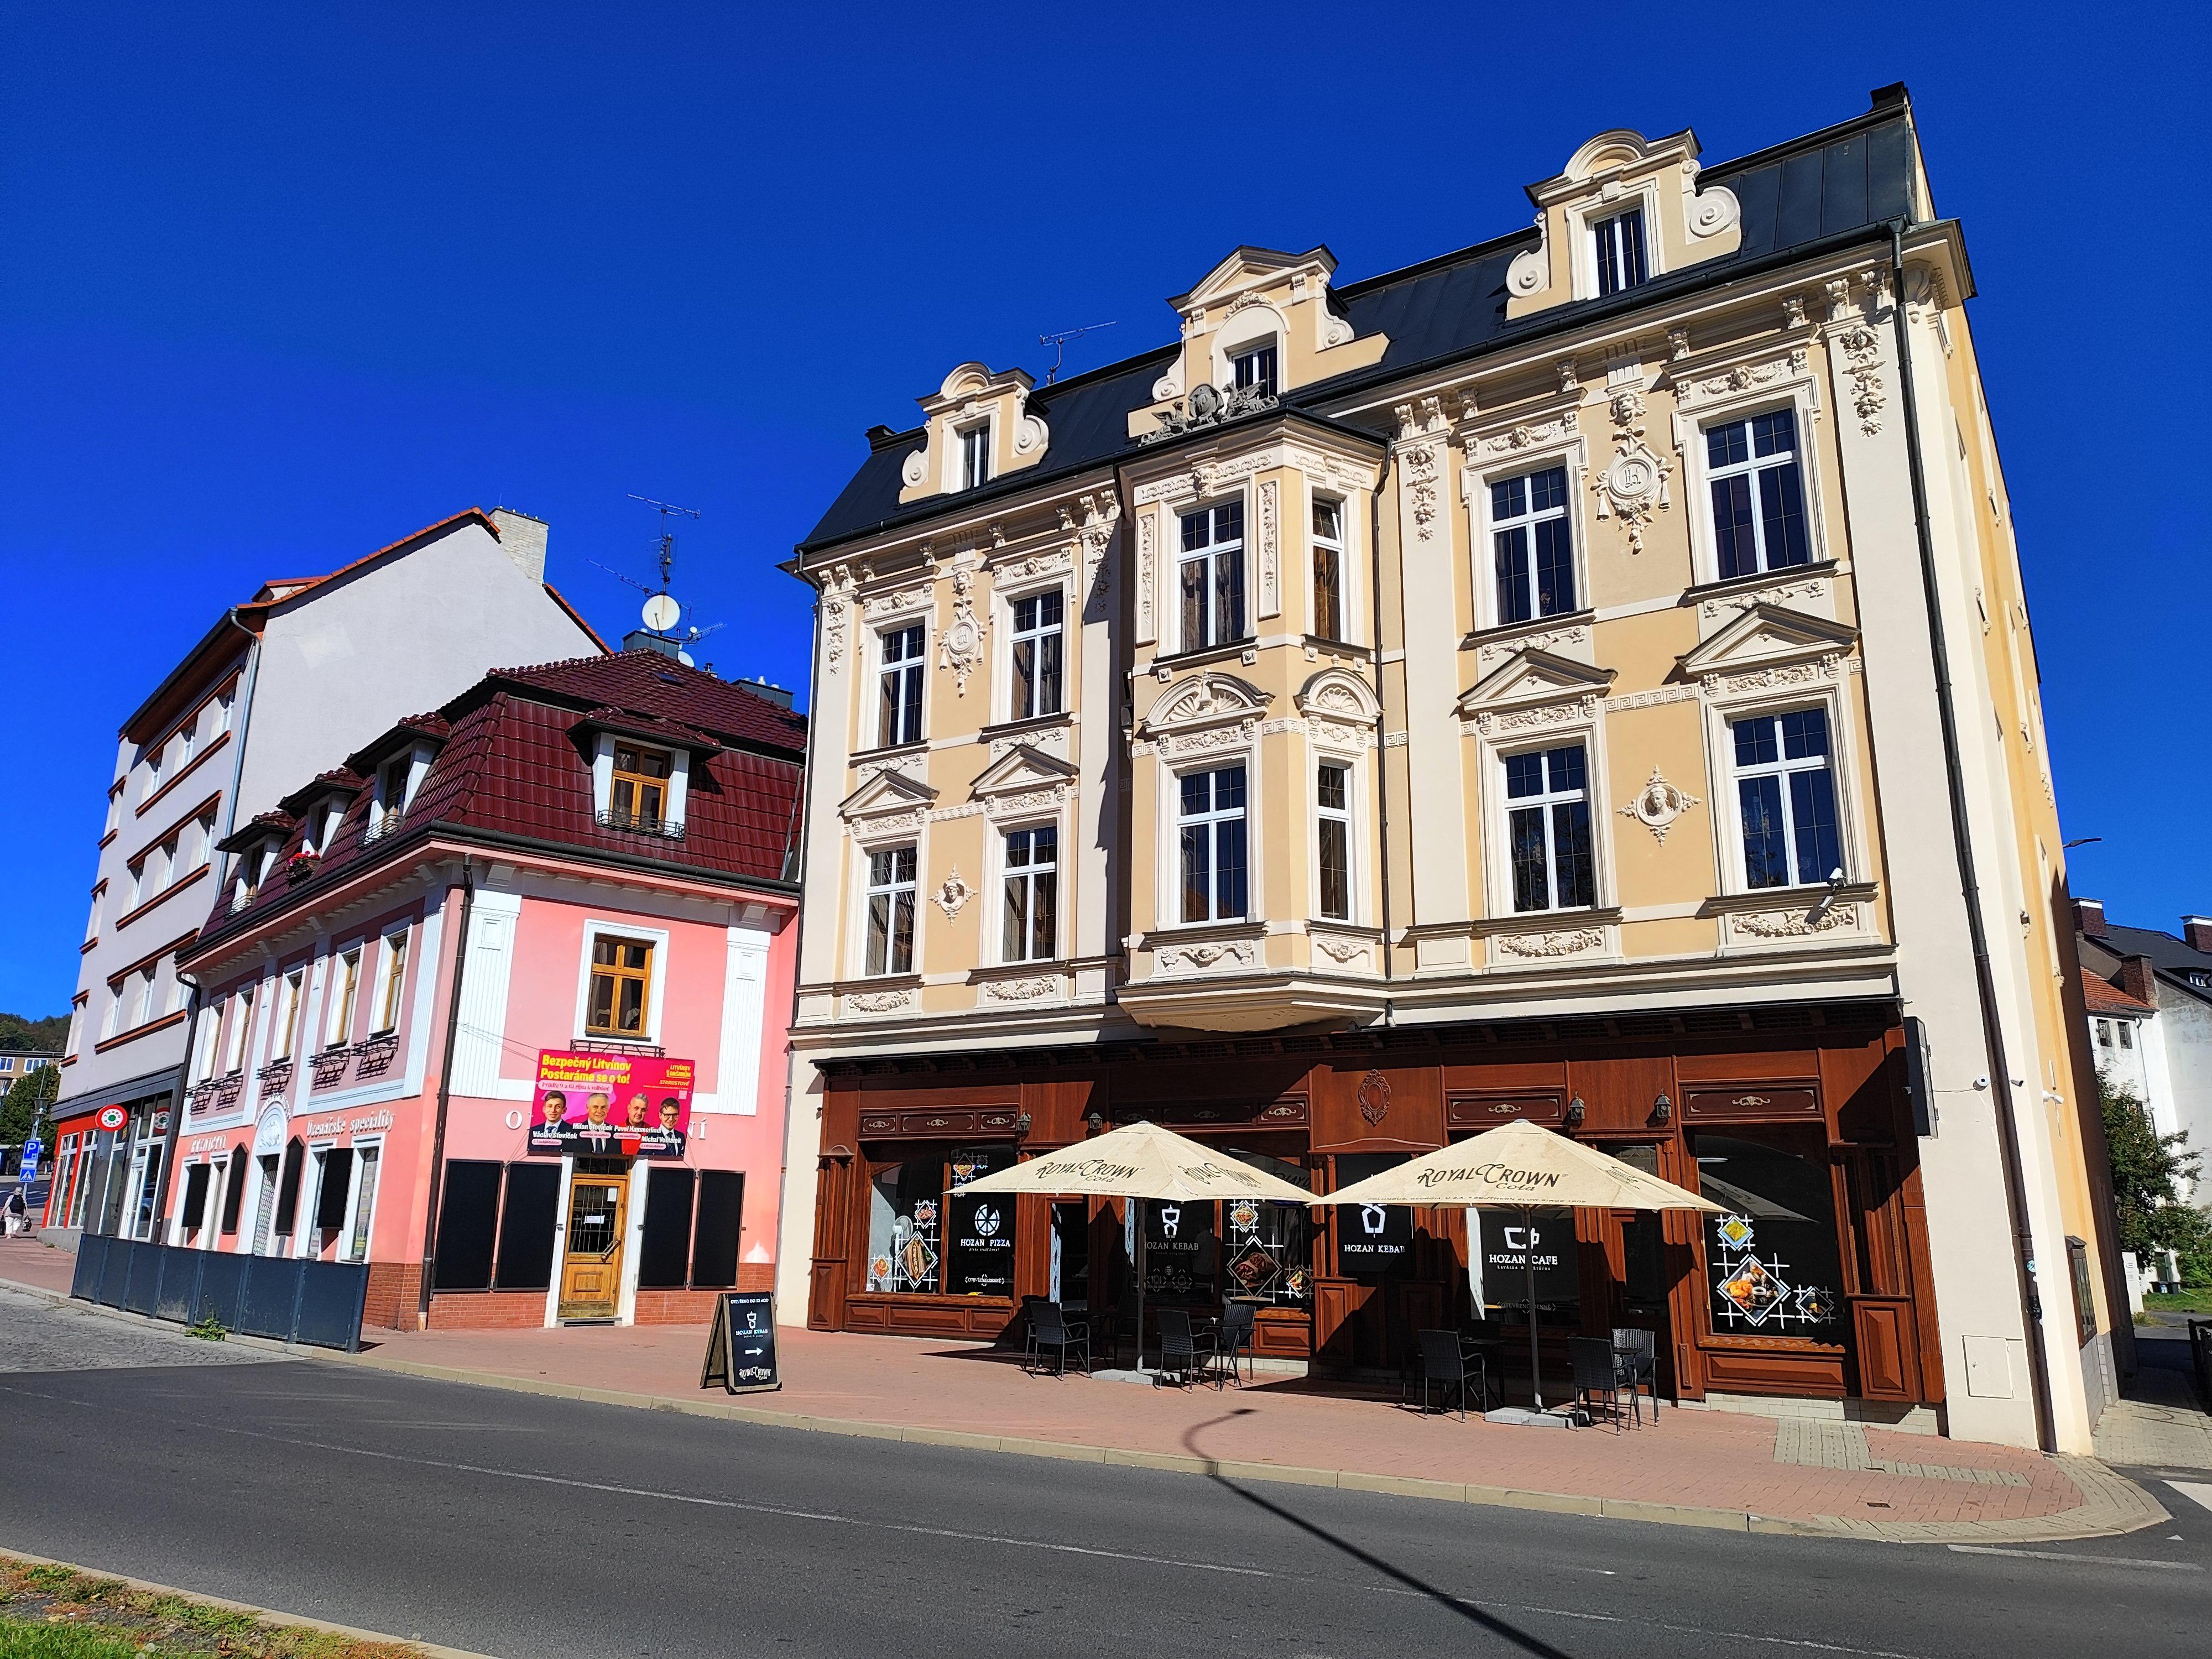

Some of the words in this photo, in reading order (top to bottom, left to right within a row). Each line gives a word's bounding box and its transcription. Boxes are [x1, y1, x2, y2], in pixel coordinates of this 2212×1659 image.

[542, 1055, 591, 1071] Bezpečný
[592, 1058, 632, 1071] Litvínov
[540, 1068, 594, 1081] Postaráme
[610, 1075, 615, 1083] o
[617, 1073, 630, 1084] to!
[349, 1109, 395, 1135] speciality
[27, 1143, 36, 1154] P
[1035, 1162, 1081, 1179] ROYAL
[1079, 1159, 1140, 1179] CROWN
[1417, 1167, 1475, 1188] ROYAL
[1475, 1164, 1560, 1187] CROWN
[1495, 1182, 1535, 1191] Cola
[1344, 1244, 1374, 1253] HOZAN
[1378, 1245, 1405, 1253] KEBAB
[1489, 1254, 1526, 1265] HOZAN
[1531, 1255, 1558, 1265] CAFE
